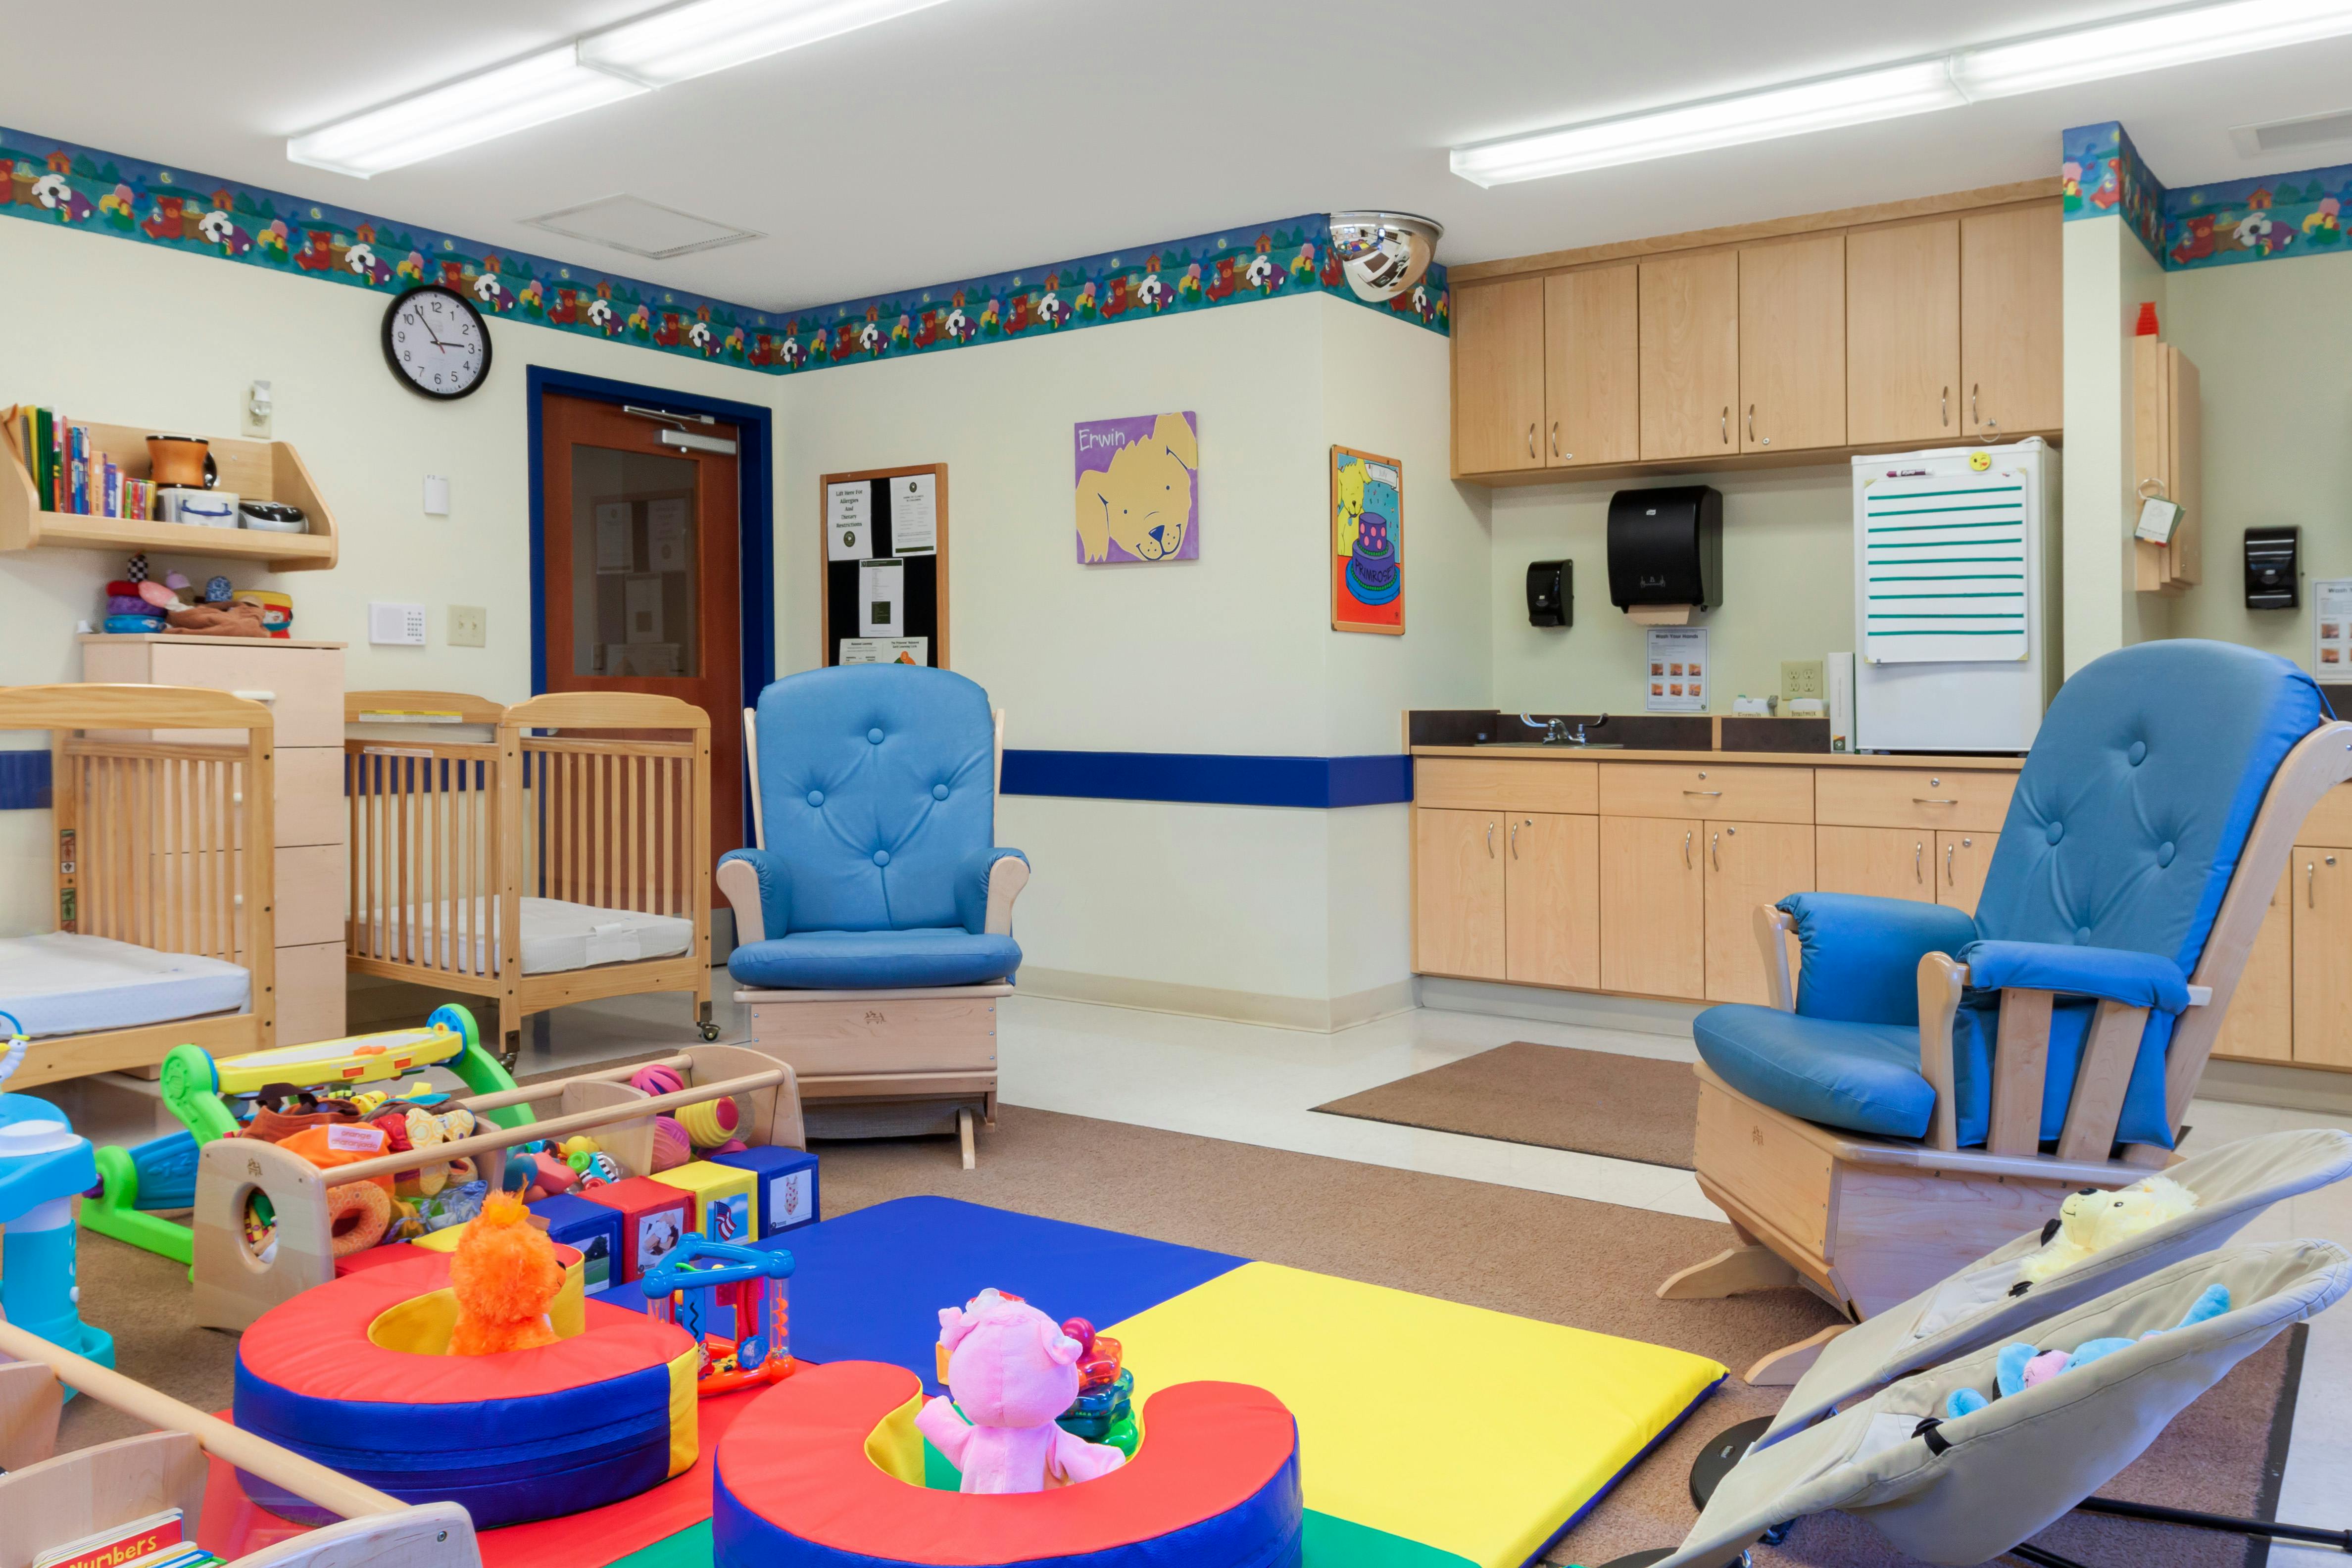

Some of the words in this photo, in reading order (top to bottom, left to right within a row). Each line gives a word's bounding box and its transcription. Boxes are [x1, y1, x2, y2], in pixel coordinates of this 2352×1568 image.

[414, 304, 423, 316] 11
[431, 301, 442, 313] 12
[403, 314, 414, 325] 10
[450, 310, 454, 321] 1
[462, 324, 469, 335] 2
[398, 331, 405, 343] 9
[468, 343, 475, 354] 3
[404, 350, 411, 361] 8
[418, 366, 425, 377] 7
[463, 361, 470, 371] 4
[434, 373, 441, 385] 6
[451, 371, 458, 382] 5
[1078, 428, 1125, 451] Erwin
[1355, 558, 1392, 583] PRIMROSE
[341, 1131, 372, 1139] orange
